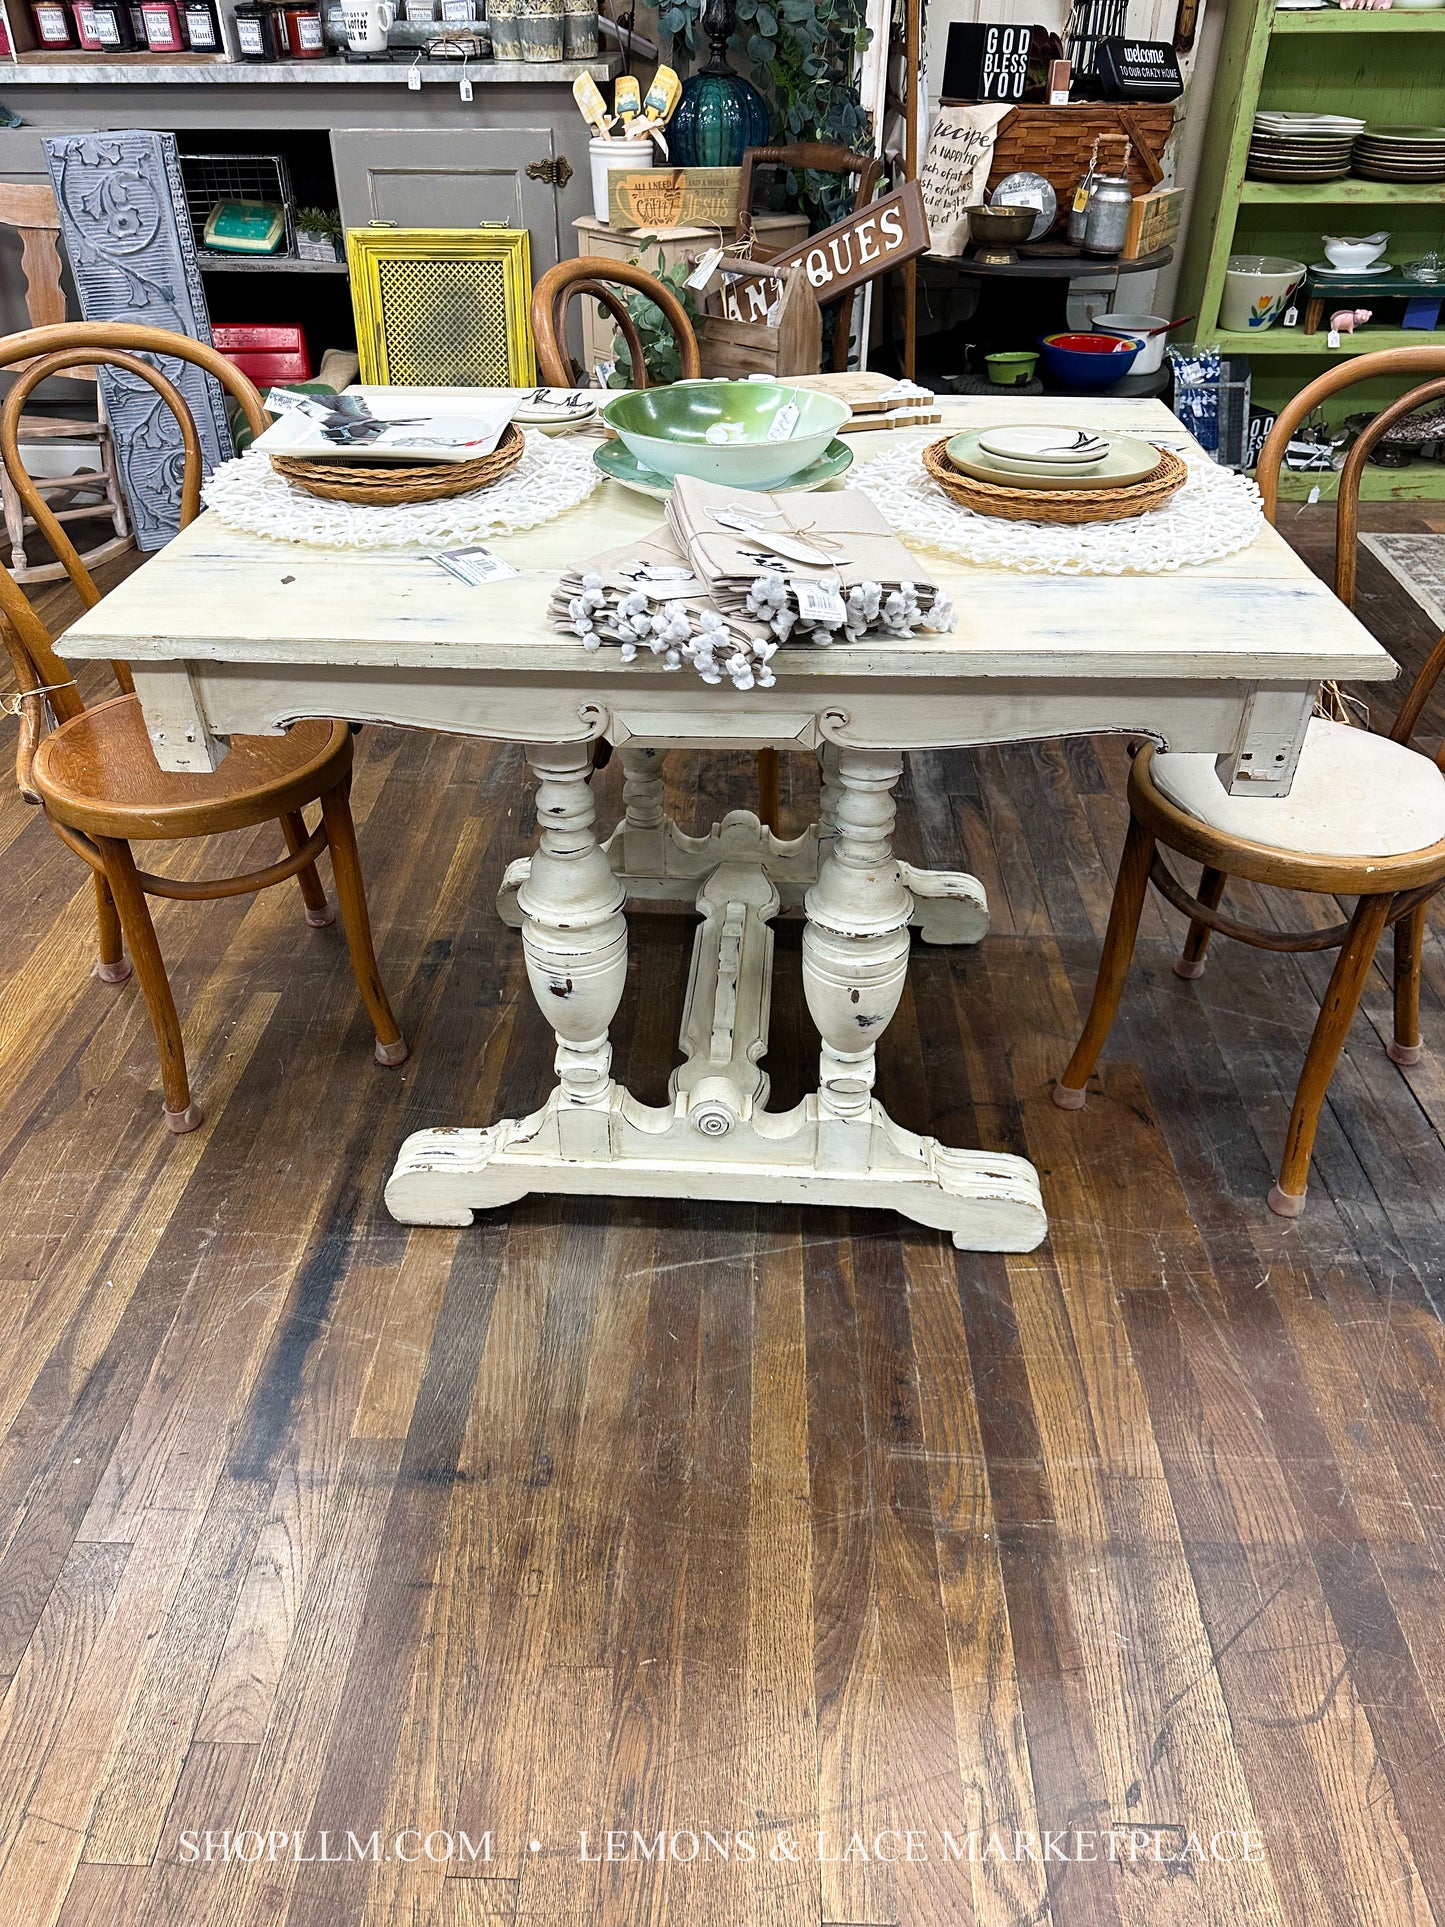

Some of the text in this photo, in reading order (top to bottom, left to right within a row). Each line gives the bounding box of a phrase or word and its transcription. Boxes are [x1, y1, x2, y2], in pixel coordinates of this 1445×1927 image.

[987, 27, 1030, 54] GOD
[984, 53, 1028, 73] BLESS
[1124, 44, 1164, 64] welcome
[1119, 65, 1179, 79] TO OUR CRAZY HOME
[983, 72, 1025, 98] YOU
[933, 118, 992, 153] recipe
[930, 144, 937, 155] A
[963, 152, 980, 166] HO
[653, 180, 672, 190] NEED
[921, 178, 934, 191] sh
[636, 197, 676, 218] COFFEE
[683, 194, 730, 219] JESUS
[727, 205, 905, 323] ANQUES
[1250, 417, 1274, 437] OD
